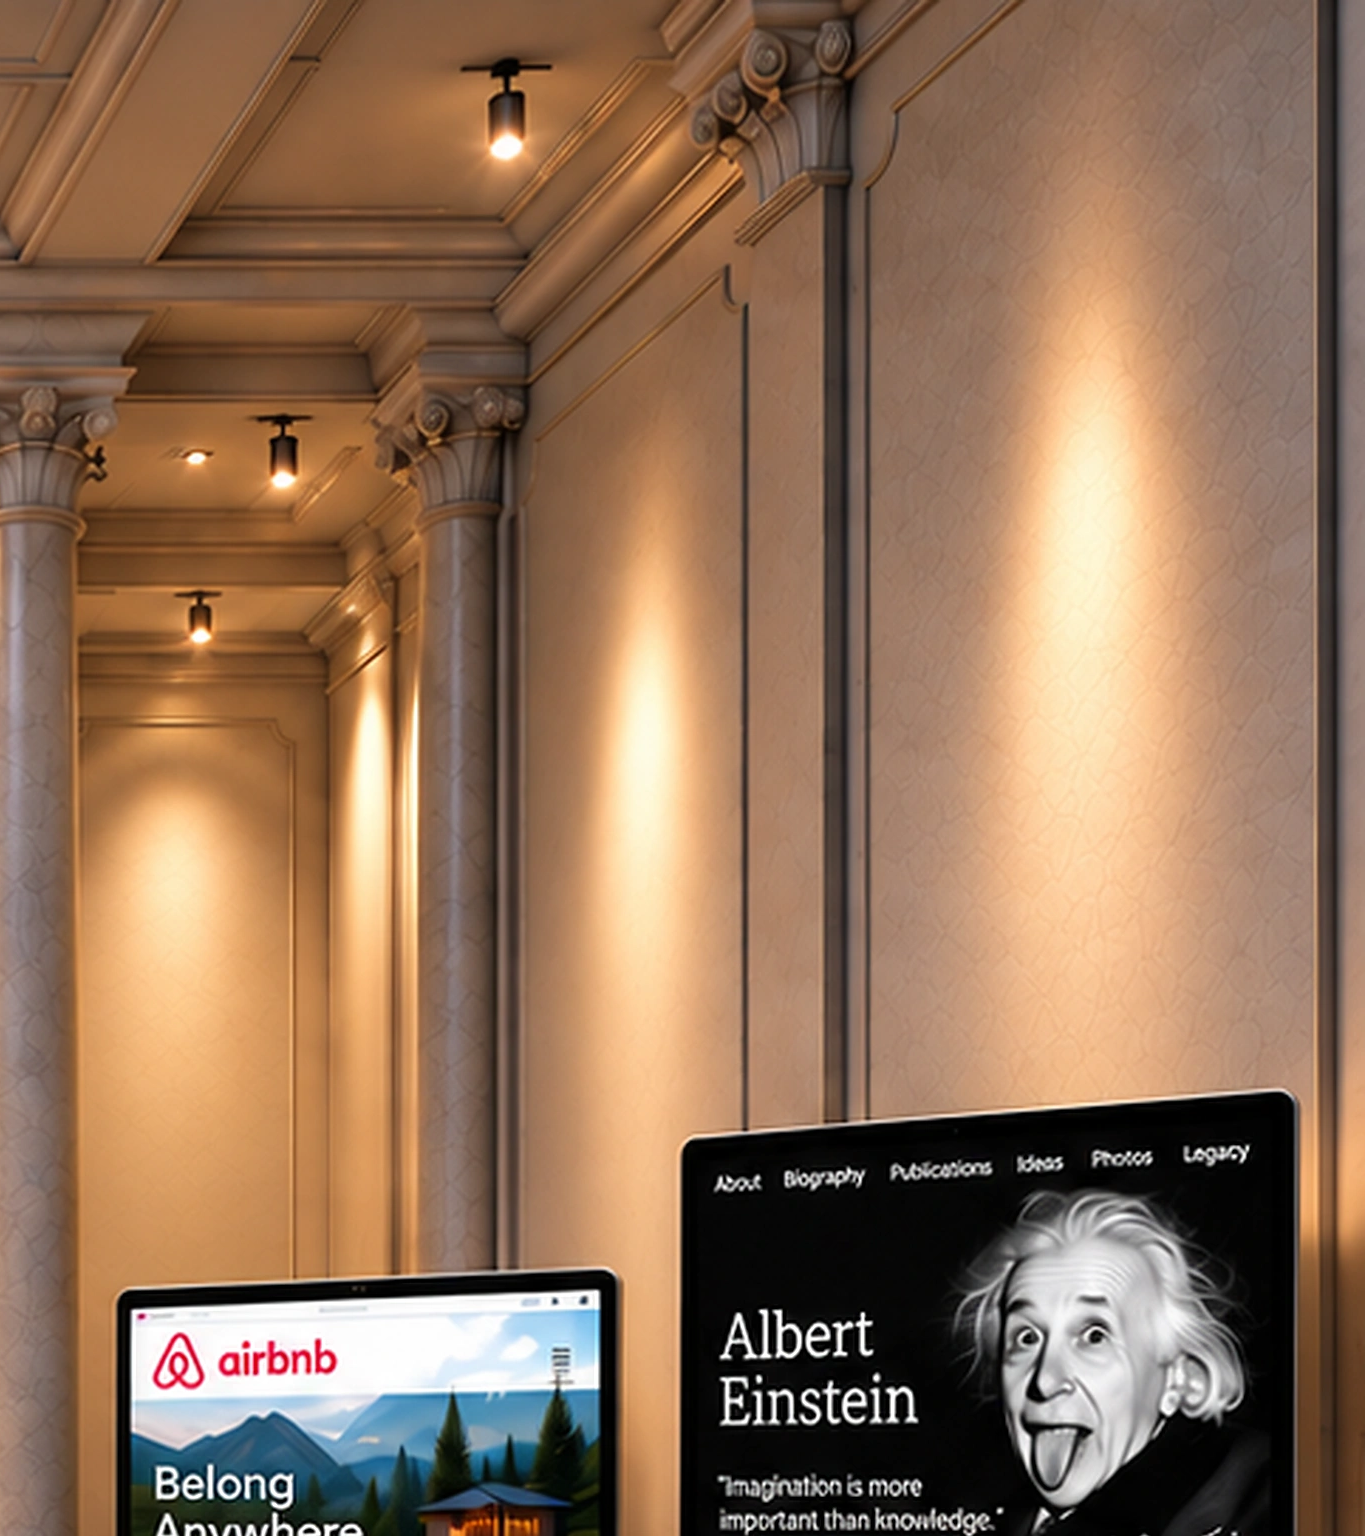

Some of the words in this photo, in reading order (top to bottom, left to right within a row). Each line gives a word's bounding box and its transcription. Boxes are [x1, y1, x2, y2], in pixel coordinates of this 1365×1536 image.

[714, 1174, 762, 1193] About
[783, 1166, 866, 1191] Biography
[890, 1159, 993, 1183] Publications
[1017, 1154, 1064, 1173] Ideas
[1091, 1149, 1154, 1168] Photos
[1183, 1144, 1250, 1167] Legacy
[719, 1308, 874, 1361] Albert
[217, 1339, 338, 1376] airbnb
[719, 1372, 919, 1426] Einstein
[155, 1464, 294, 1509] Belong
[846, 1474, 864, 1497] is
[868, 1478, 923, 1498] more
[719, 1509, 819, 1536] important
[823, 1508, 871, 1531] than
